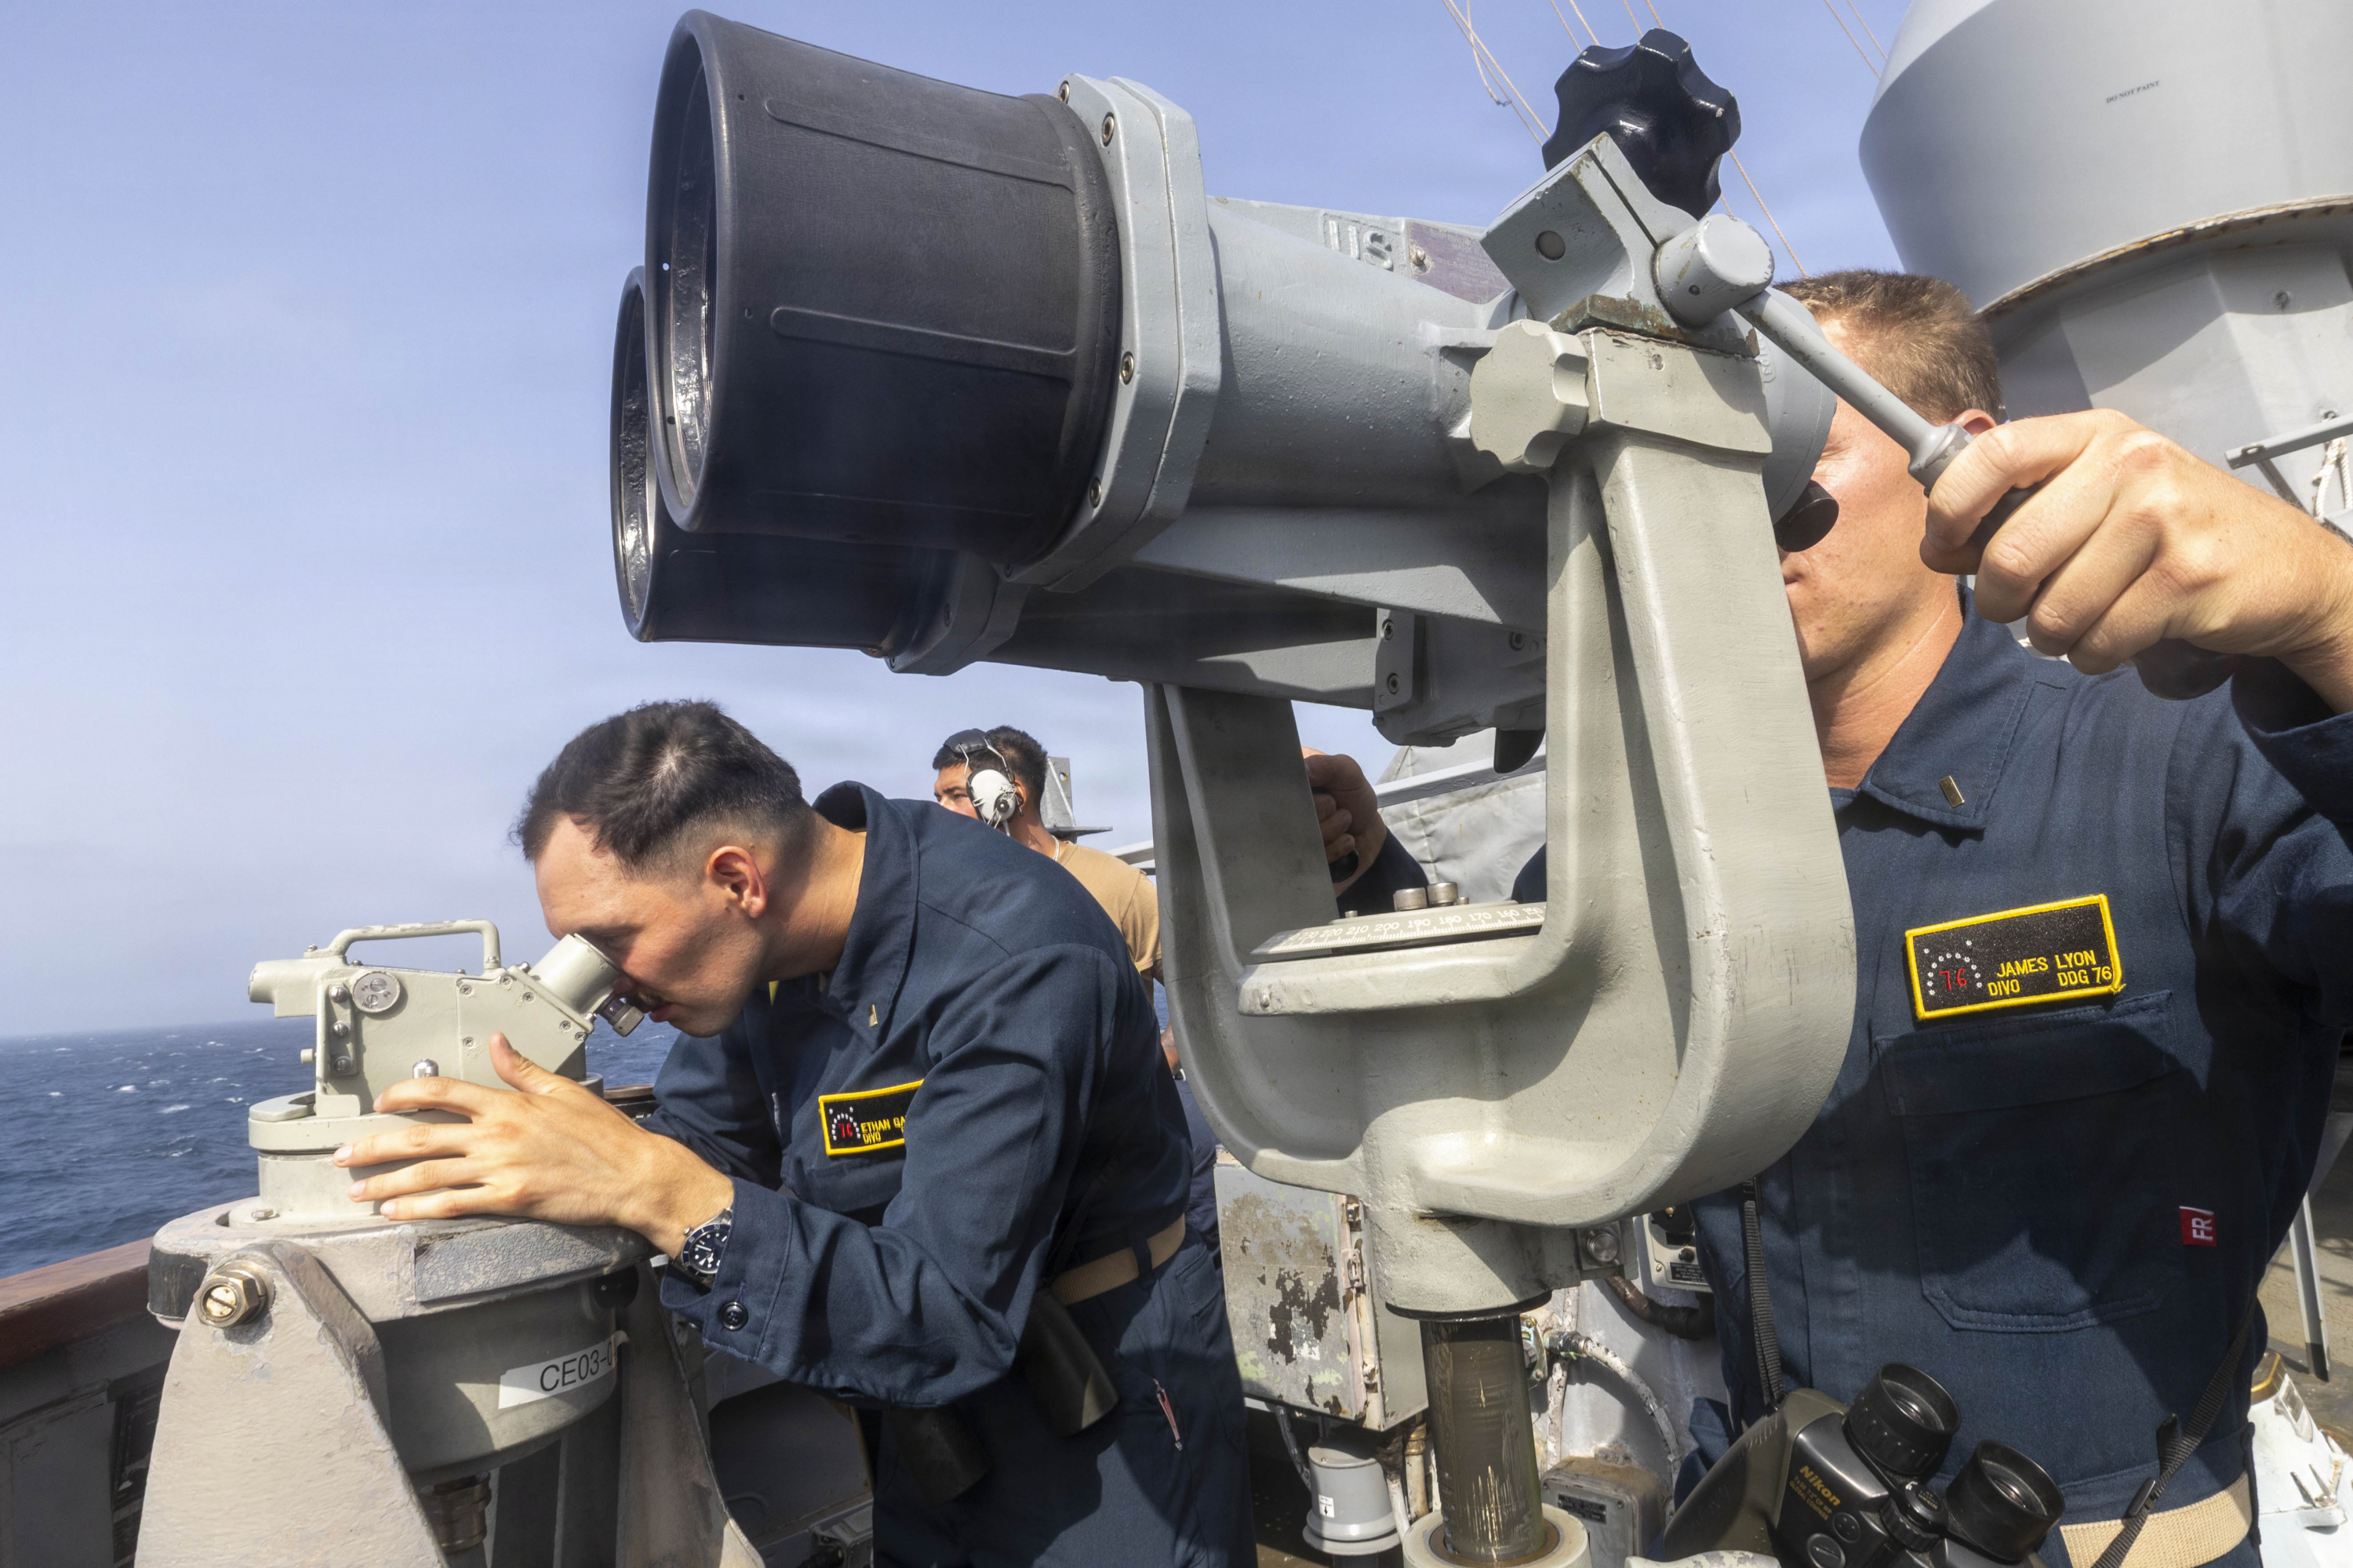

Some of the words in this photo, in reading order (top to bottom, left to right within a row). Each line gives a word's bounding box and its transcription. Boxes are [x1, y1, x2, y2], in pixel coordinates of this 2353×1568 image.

[2106, 95, 2118, 104] DO
[2119, 88, 2135, 97] NOT
[2137, 80, 2159, 93] PAINT
[1319, 928, 1343, 938] 220
[1345, 925, 1369, 935] 210
[1374, 922, 1399, 932] 200
[1407, 918, 1431, 928] 190
[1438, 915, 1462, 925] 180
[1468, 911, 1492, 922] 170
[1497, 909, 1520, 919] 160
[1522, 907, 1544, 916] 150
[1996, 957, 2049, 978] JAMES
[2054, 949, 2097, 969] LYON
[1939, 968, 1967, 991] 76
[1988, 979, 2020, 997] DIVO
[2057, 970, 2089, 987] DDG
[2091, 966, 2113, 984] 76
[860, 1119, 891, 1133] ETHAN
[893, 1115, 907, 1129] GA
[863, 1131, 882, 1144] DIVO
[2192, 1217, 2213, 1241] FR
[540, 1341, 615, 1392] CE03-0
[1799, 1465, 1841, 1506] Nikon
